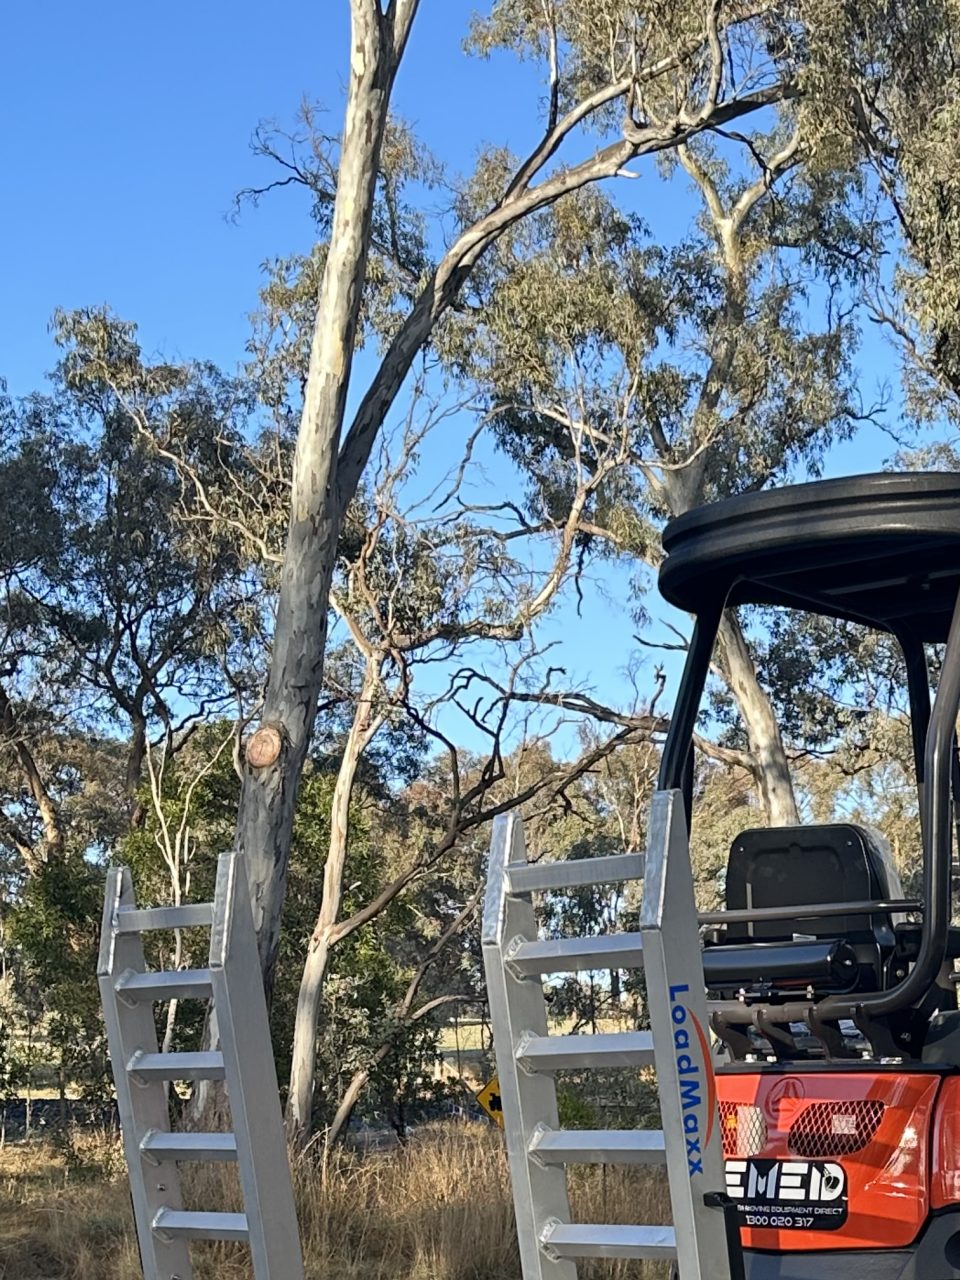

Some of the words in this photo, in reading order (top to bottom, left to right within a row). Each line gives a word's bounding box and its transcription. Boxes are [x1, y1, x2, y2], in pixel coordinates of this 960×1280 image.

[669, 984, 703, 1177] LoadMaxx
[725, 1160, 845, 1201] EMED
[745, 1215, 768, 1225] 1300
[770, 1216, 793, 1226] 020
[794, 1217, 814, 1227] 317
[814, 1207, 843, 1215] DIRECT
